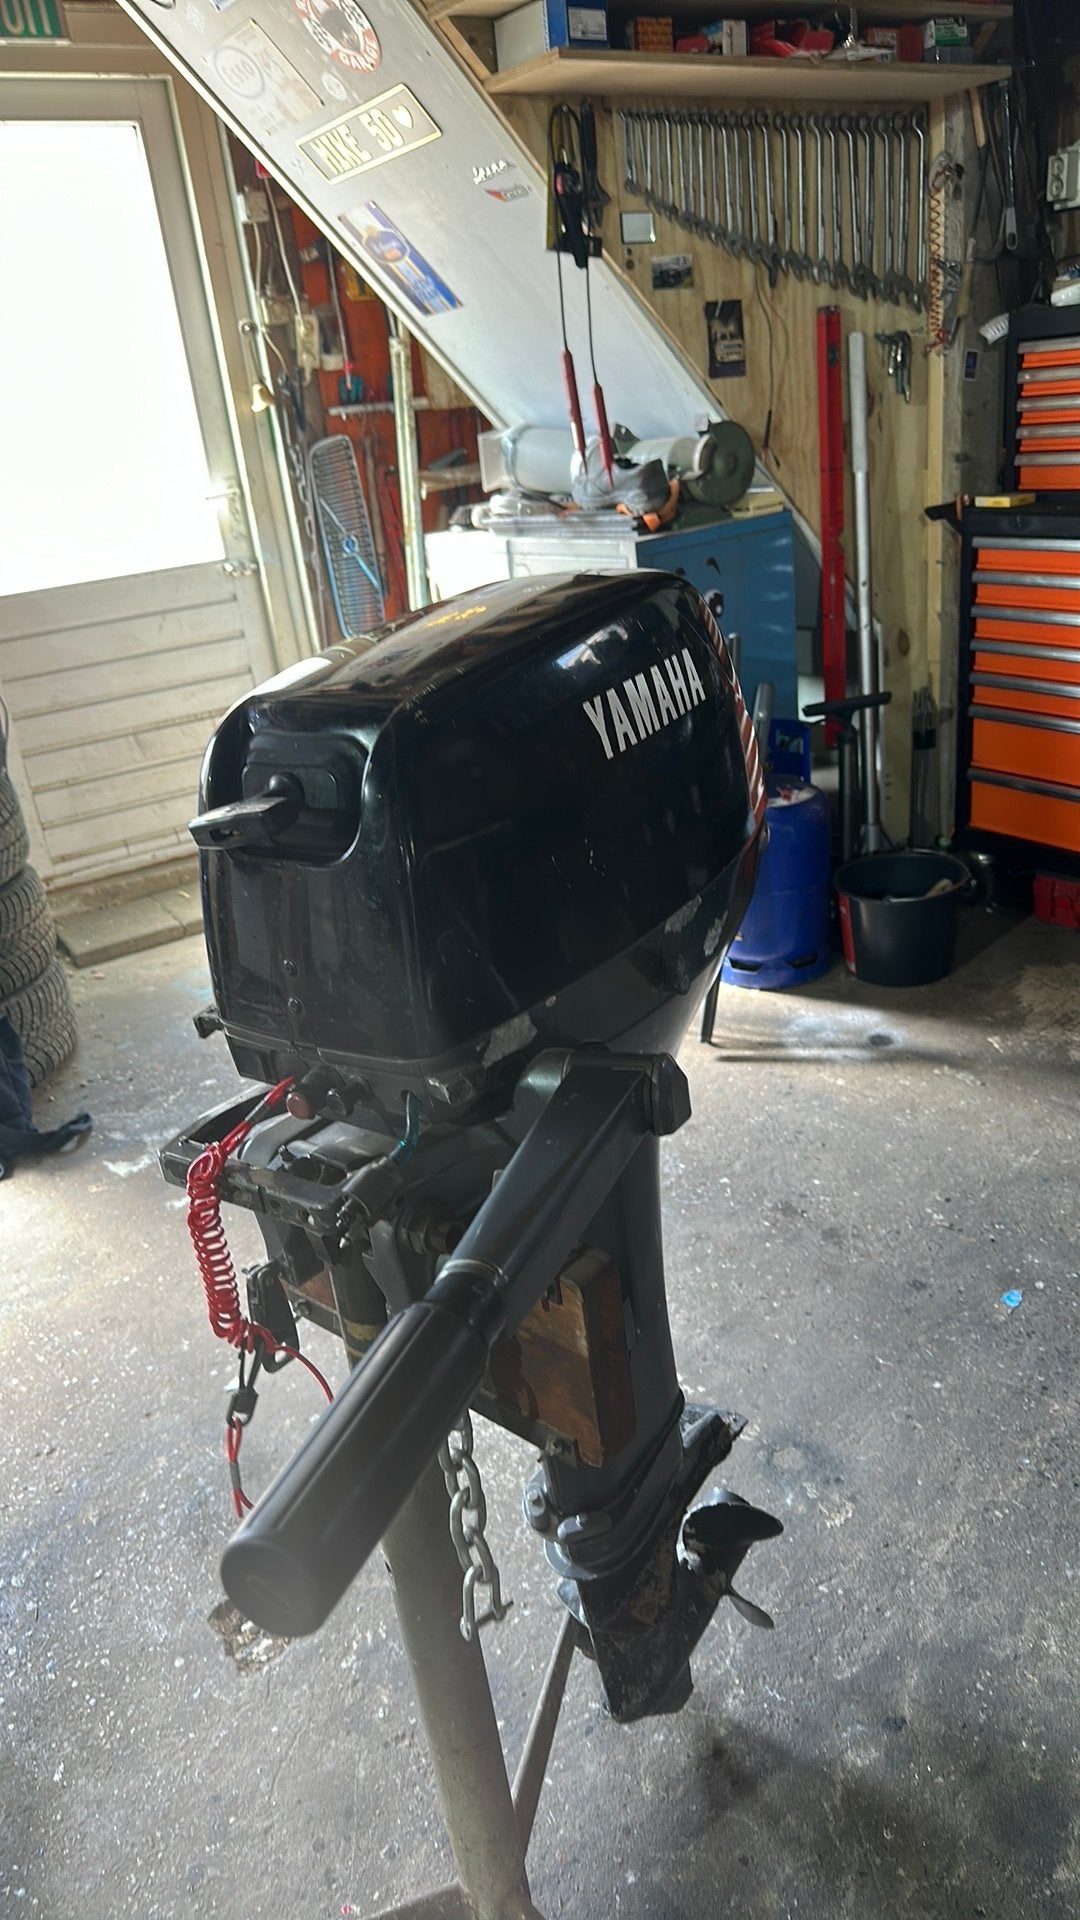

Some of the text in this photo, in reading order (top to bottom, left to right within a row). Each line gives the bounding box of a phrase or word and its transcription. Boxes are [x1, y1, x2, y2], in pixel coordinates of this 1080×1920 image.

[338, 36, 379, 73] GARAGE
[358, 107, 404, 152] 50
[582, 647, 707, 761] YAMAHA
